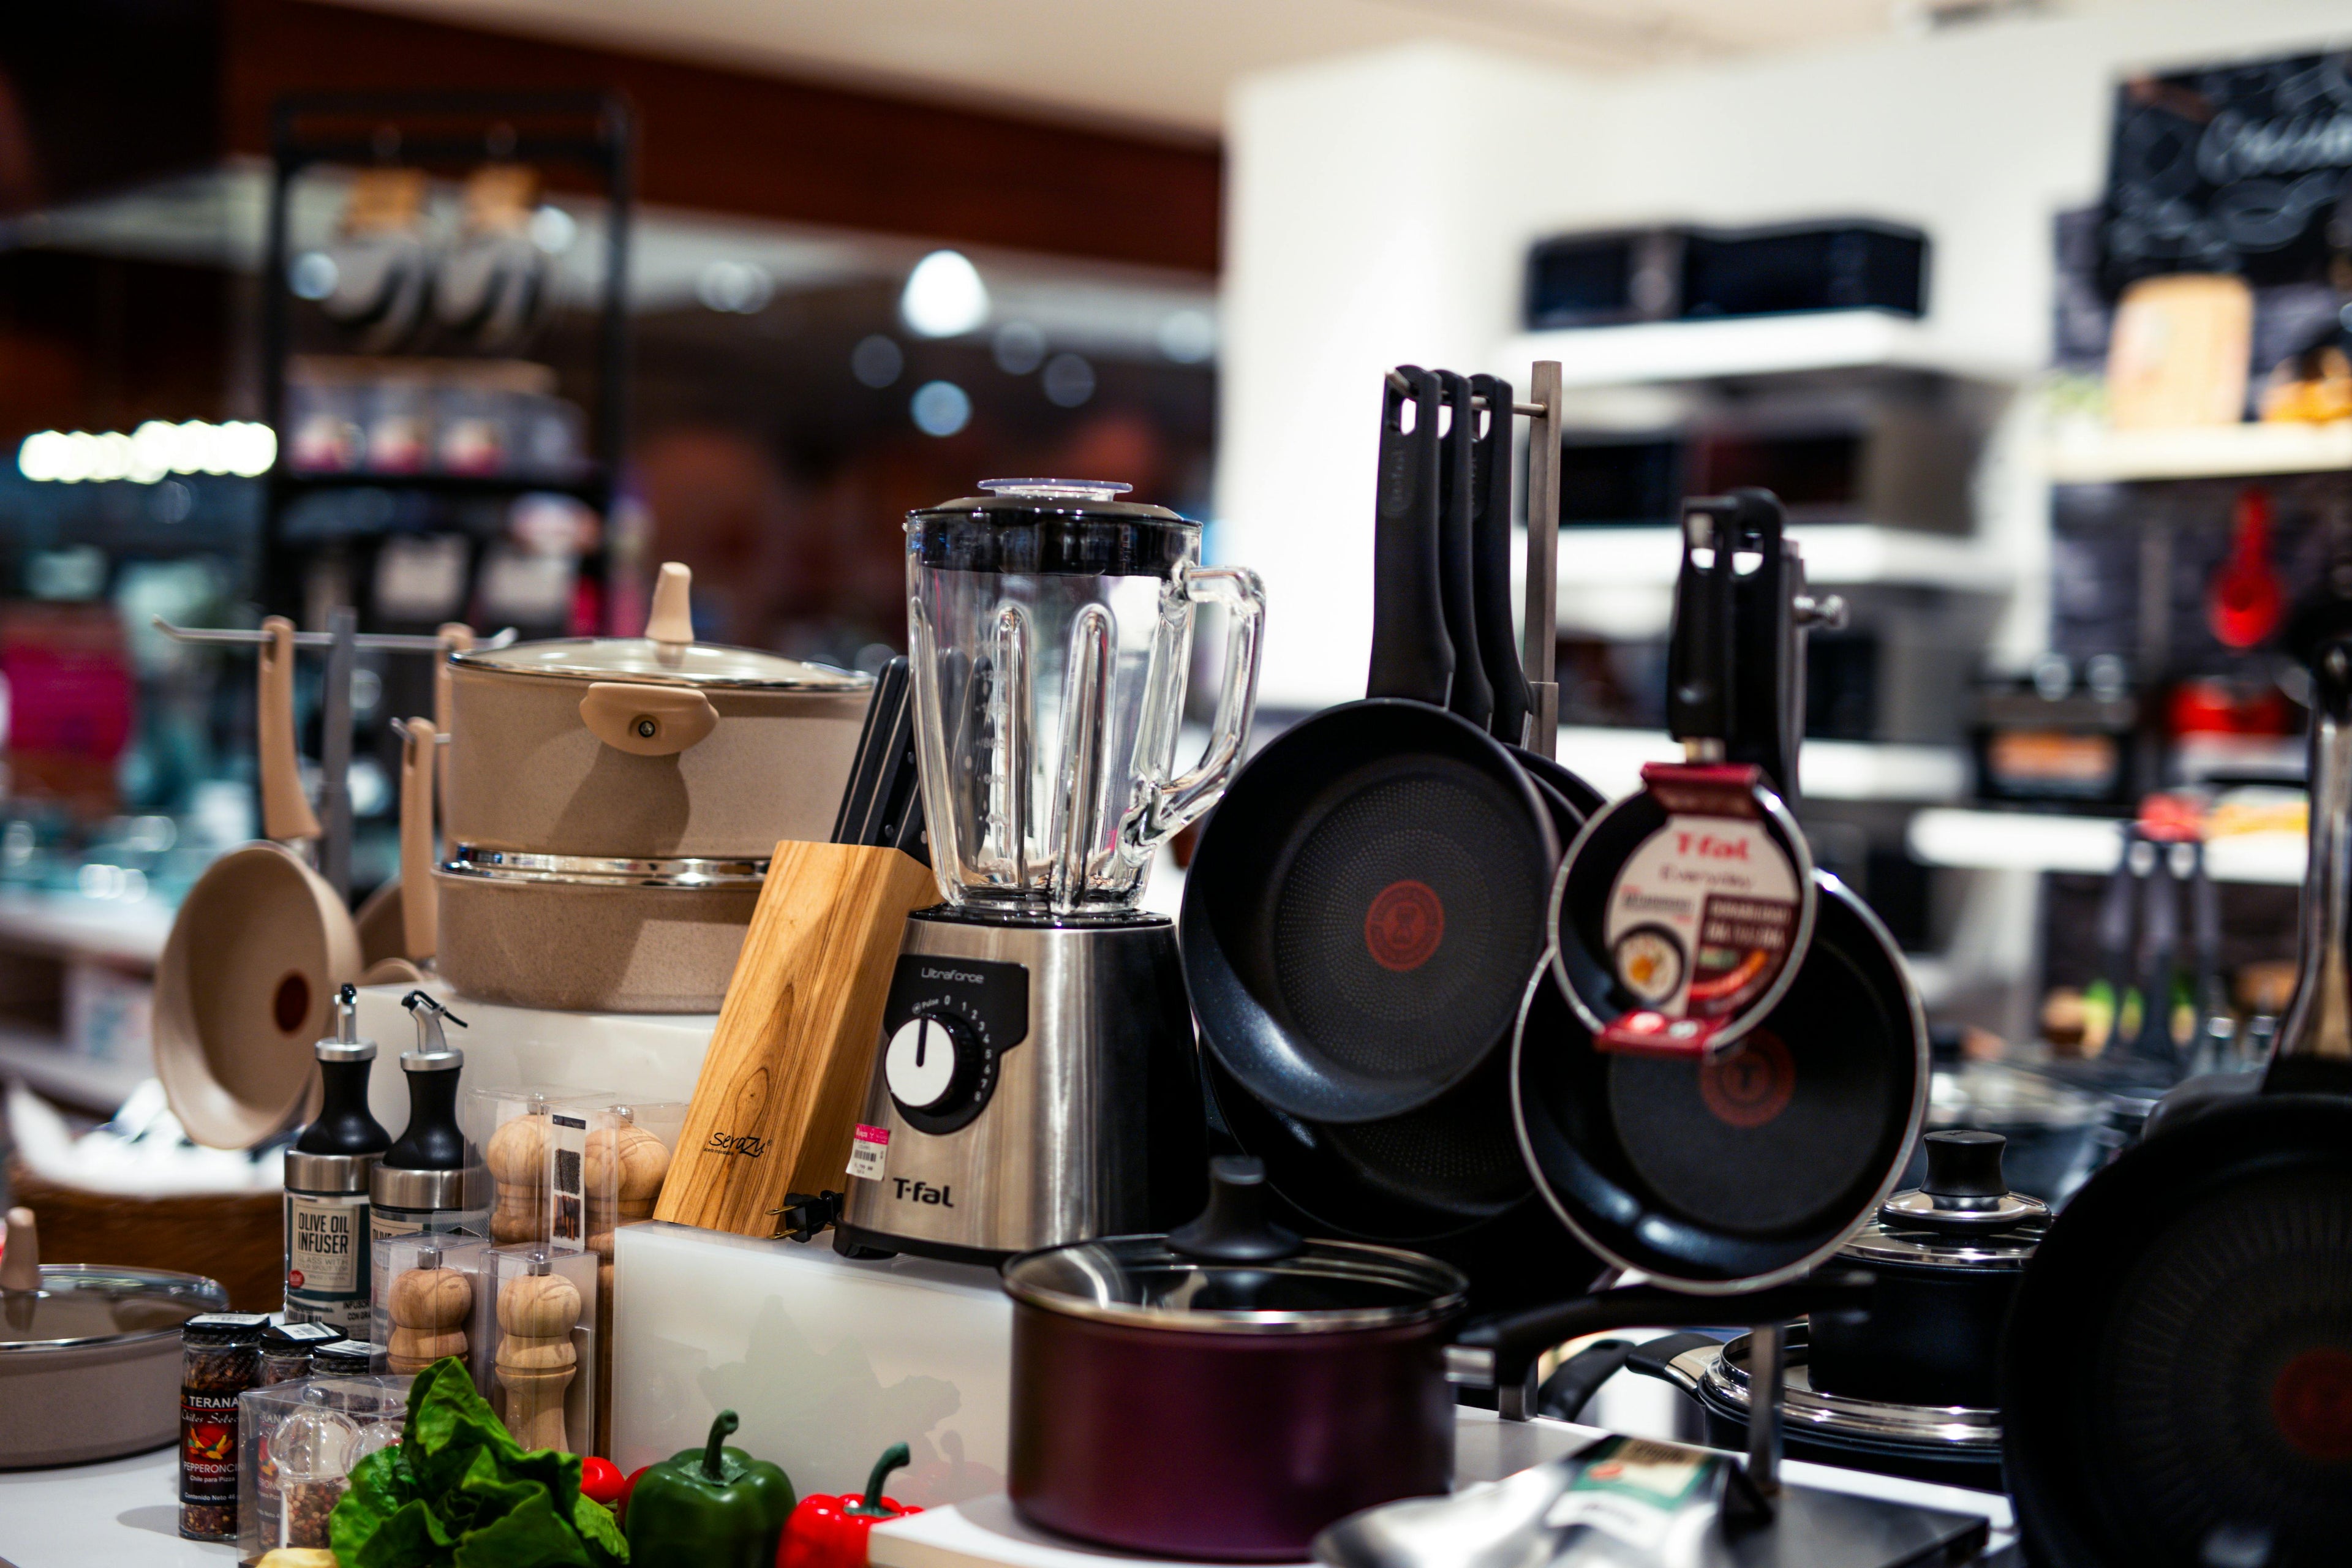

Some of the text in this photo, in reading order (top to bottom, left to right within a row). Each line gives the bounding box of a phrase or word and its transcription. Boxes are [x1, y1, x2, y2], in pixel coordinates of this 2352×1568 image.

[921, 967, 984, 984] Ultraforce
[962, 1001, 967, 1011] 1
[971, 1009, 978, 1020] 2
[979, 1022, 985, 1031] 3
[983, 1033, 990, 1044] 4
[984, 1049, 992, 1059] 5
[984, 1064, 990, 1074] 6
[981, 1079, 988, 1088] 7
[974, 1091, 981, 1101] 8
[893, 1177, 954, 1208] T-fal
[298, 1212, 349, 1234] OLIVE OIL
[298, 1231, 348, 1254] INFUSER
[189, 1396, 239, 1408] TERANA
